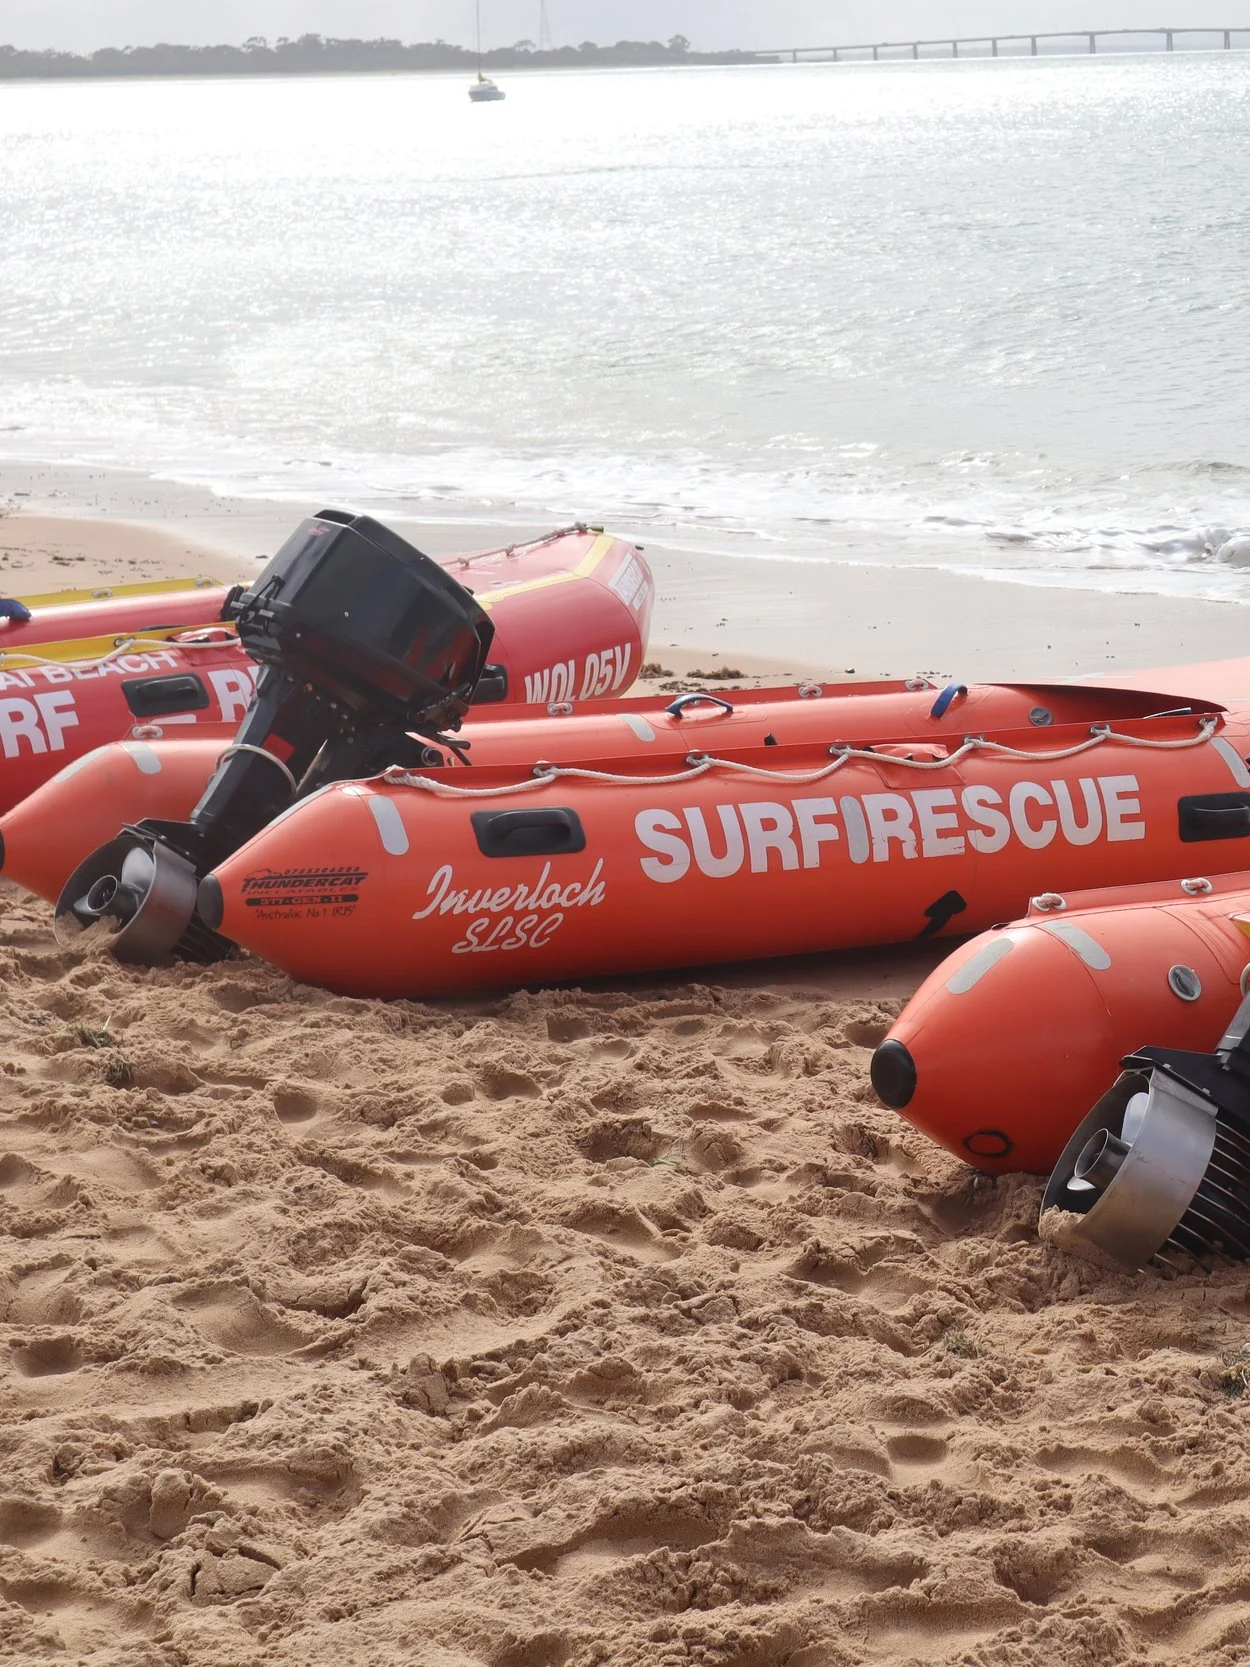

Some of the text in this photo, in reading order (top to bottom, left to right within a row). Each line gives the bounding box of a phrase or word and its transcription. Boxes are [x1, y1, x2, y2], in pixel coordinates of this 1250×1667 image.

[40, 650, 178, 684] BEACH
[524, 659, 576, 704] WOL
[864, 774, 1146, 863] RESCUE
[241, 877, 367, 893] THUNDERCAT
[412, 857, 606, 920] Inverloch
[452, 912, 564, 954] SLSC
